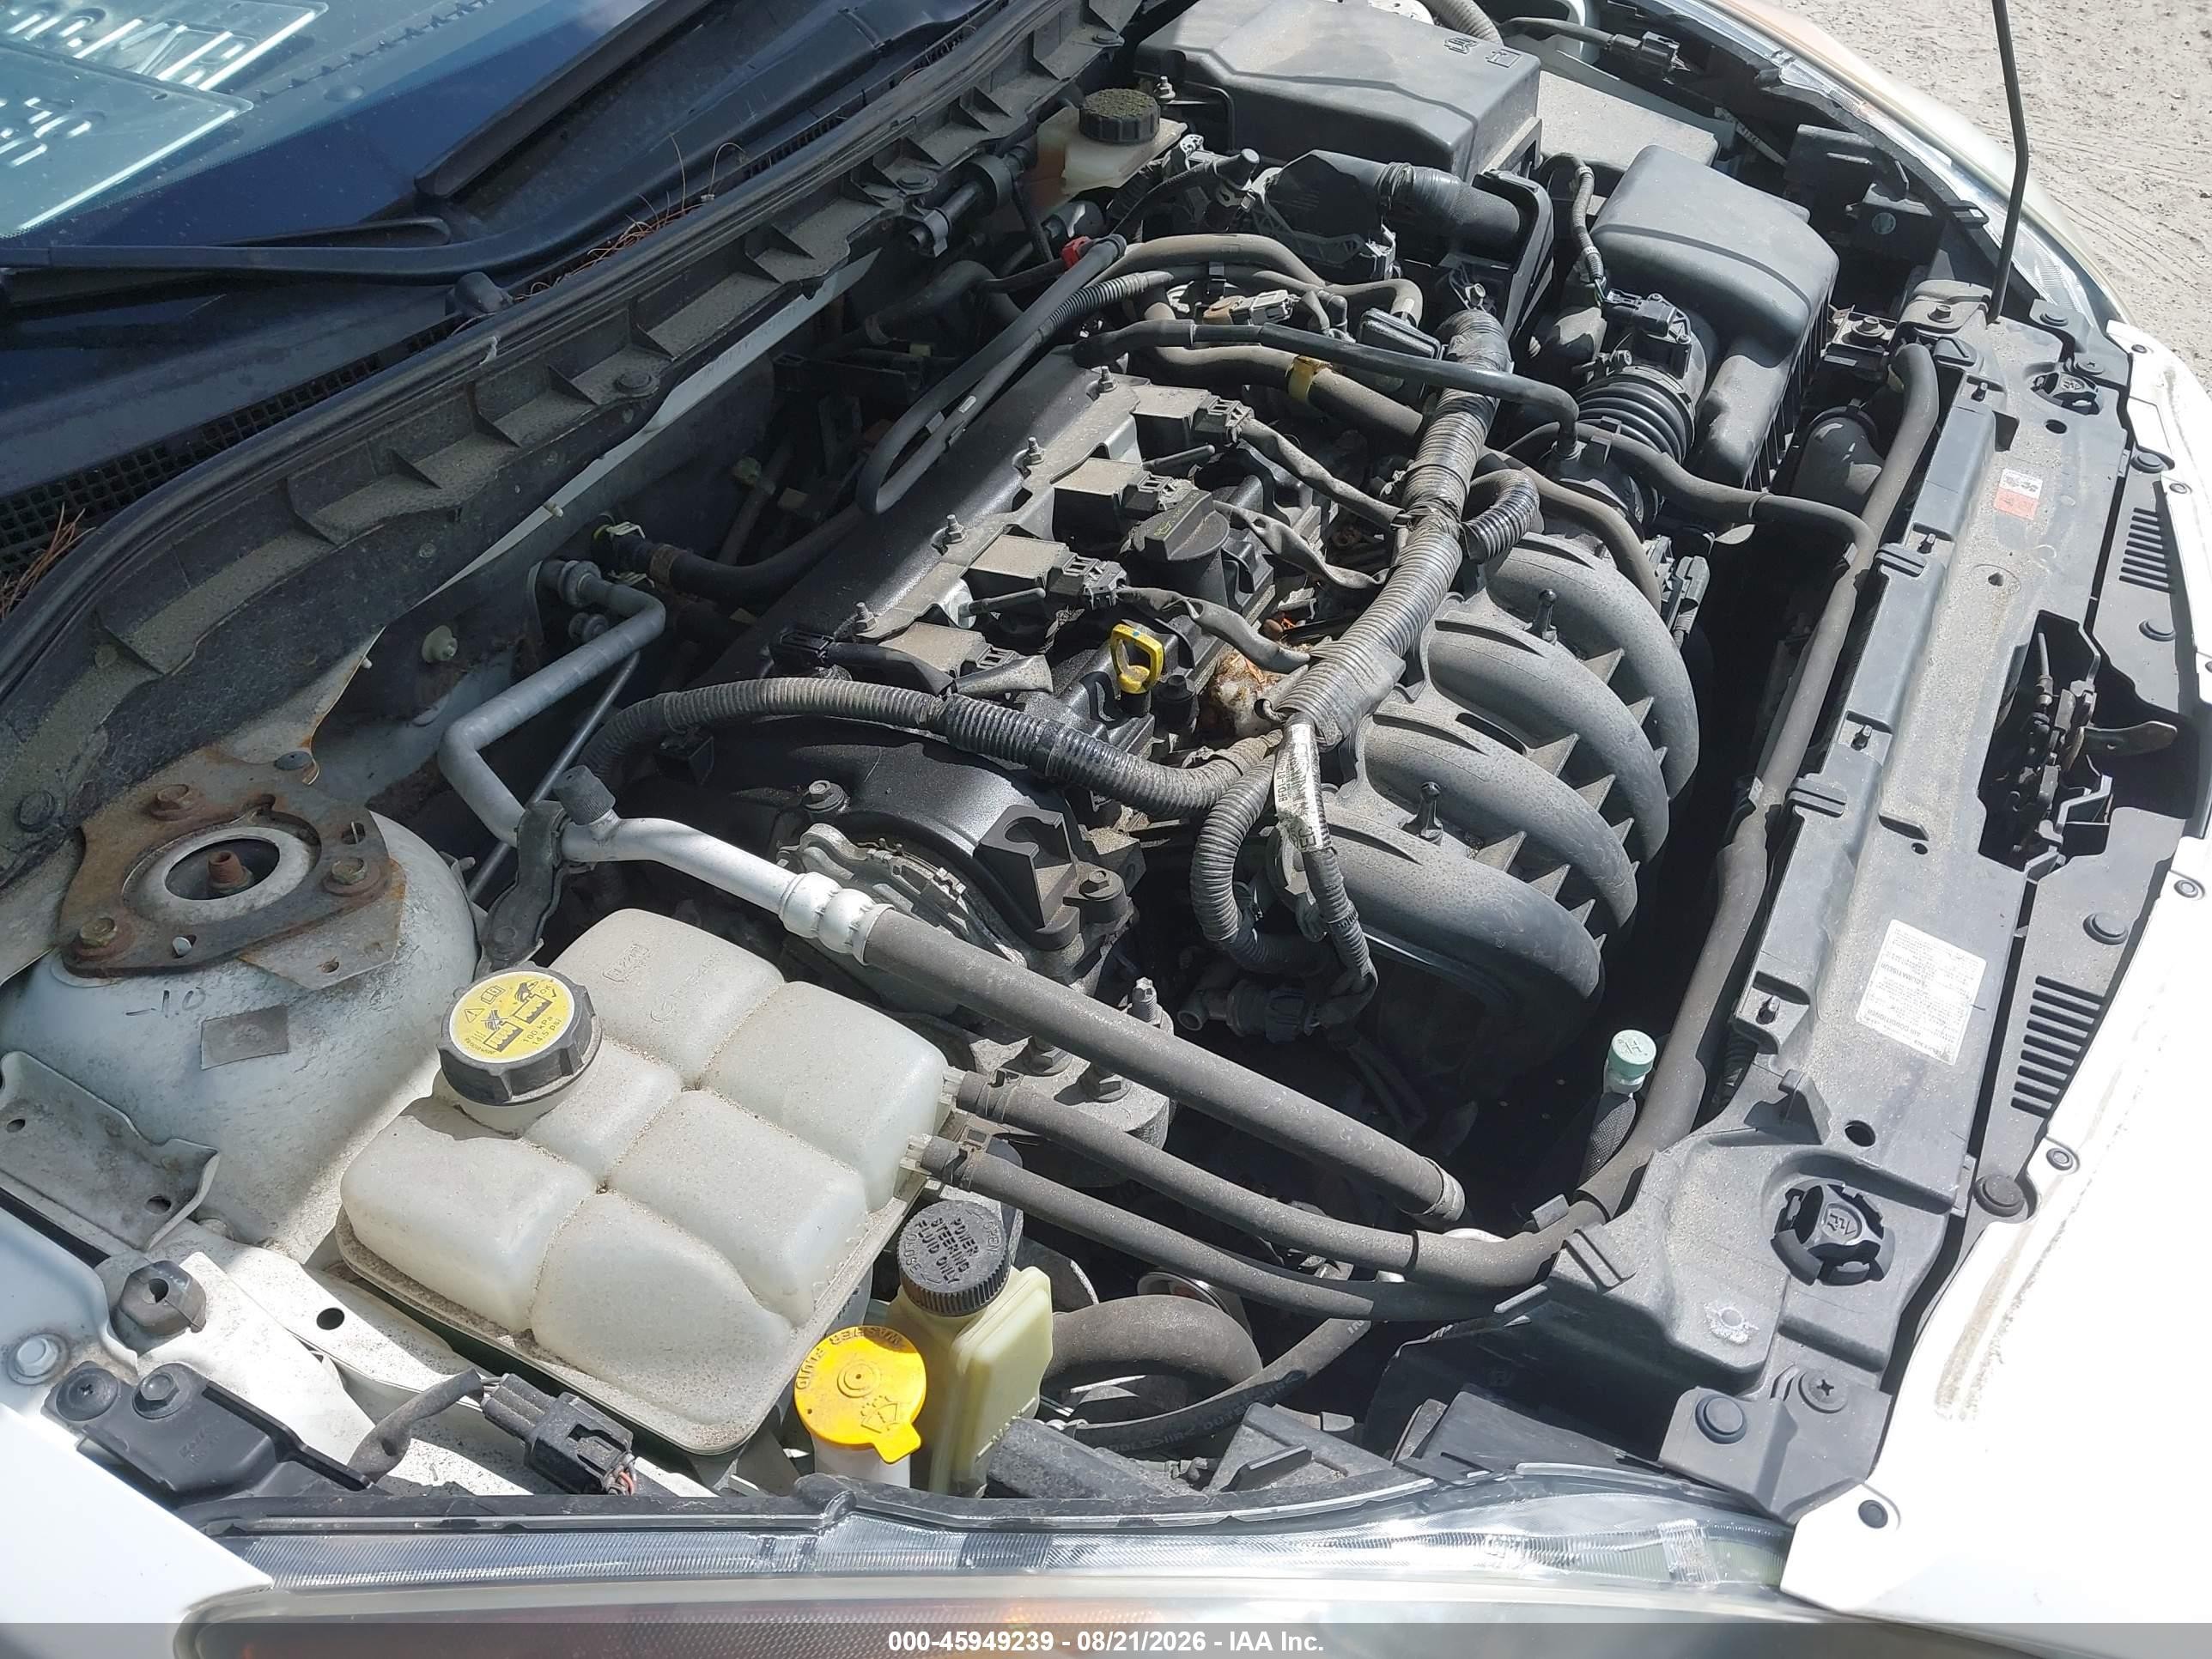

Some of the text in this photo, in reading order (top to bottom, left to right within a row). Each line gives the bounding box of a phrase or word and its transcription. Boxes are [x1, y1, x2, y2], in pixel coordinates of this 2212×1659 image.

[523, 1016, 554, 1042] 100 kPa
[532, 1018, 562, 1044] 14.5 psi
[903, 1233, 922, 1274] CLOSE
[915, 1219, 960, 1284] FLUID ONLY
[931, 1217, 970, 1273] STEERING
[951, 1218, 980, 1256] POWER
[983, 1221, 1000, 1253] OPEN
[795, 1327, 902, 1389] WASHER FLUID
